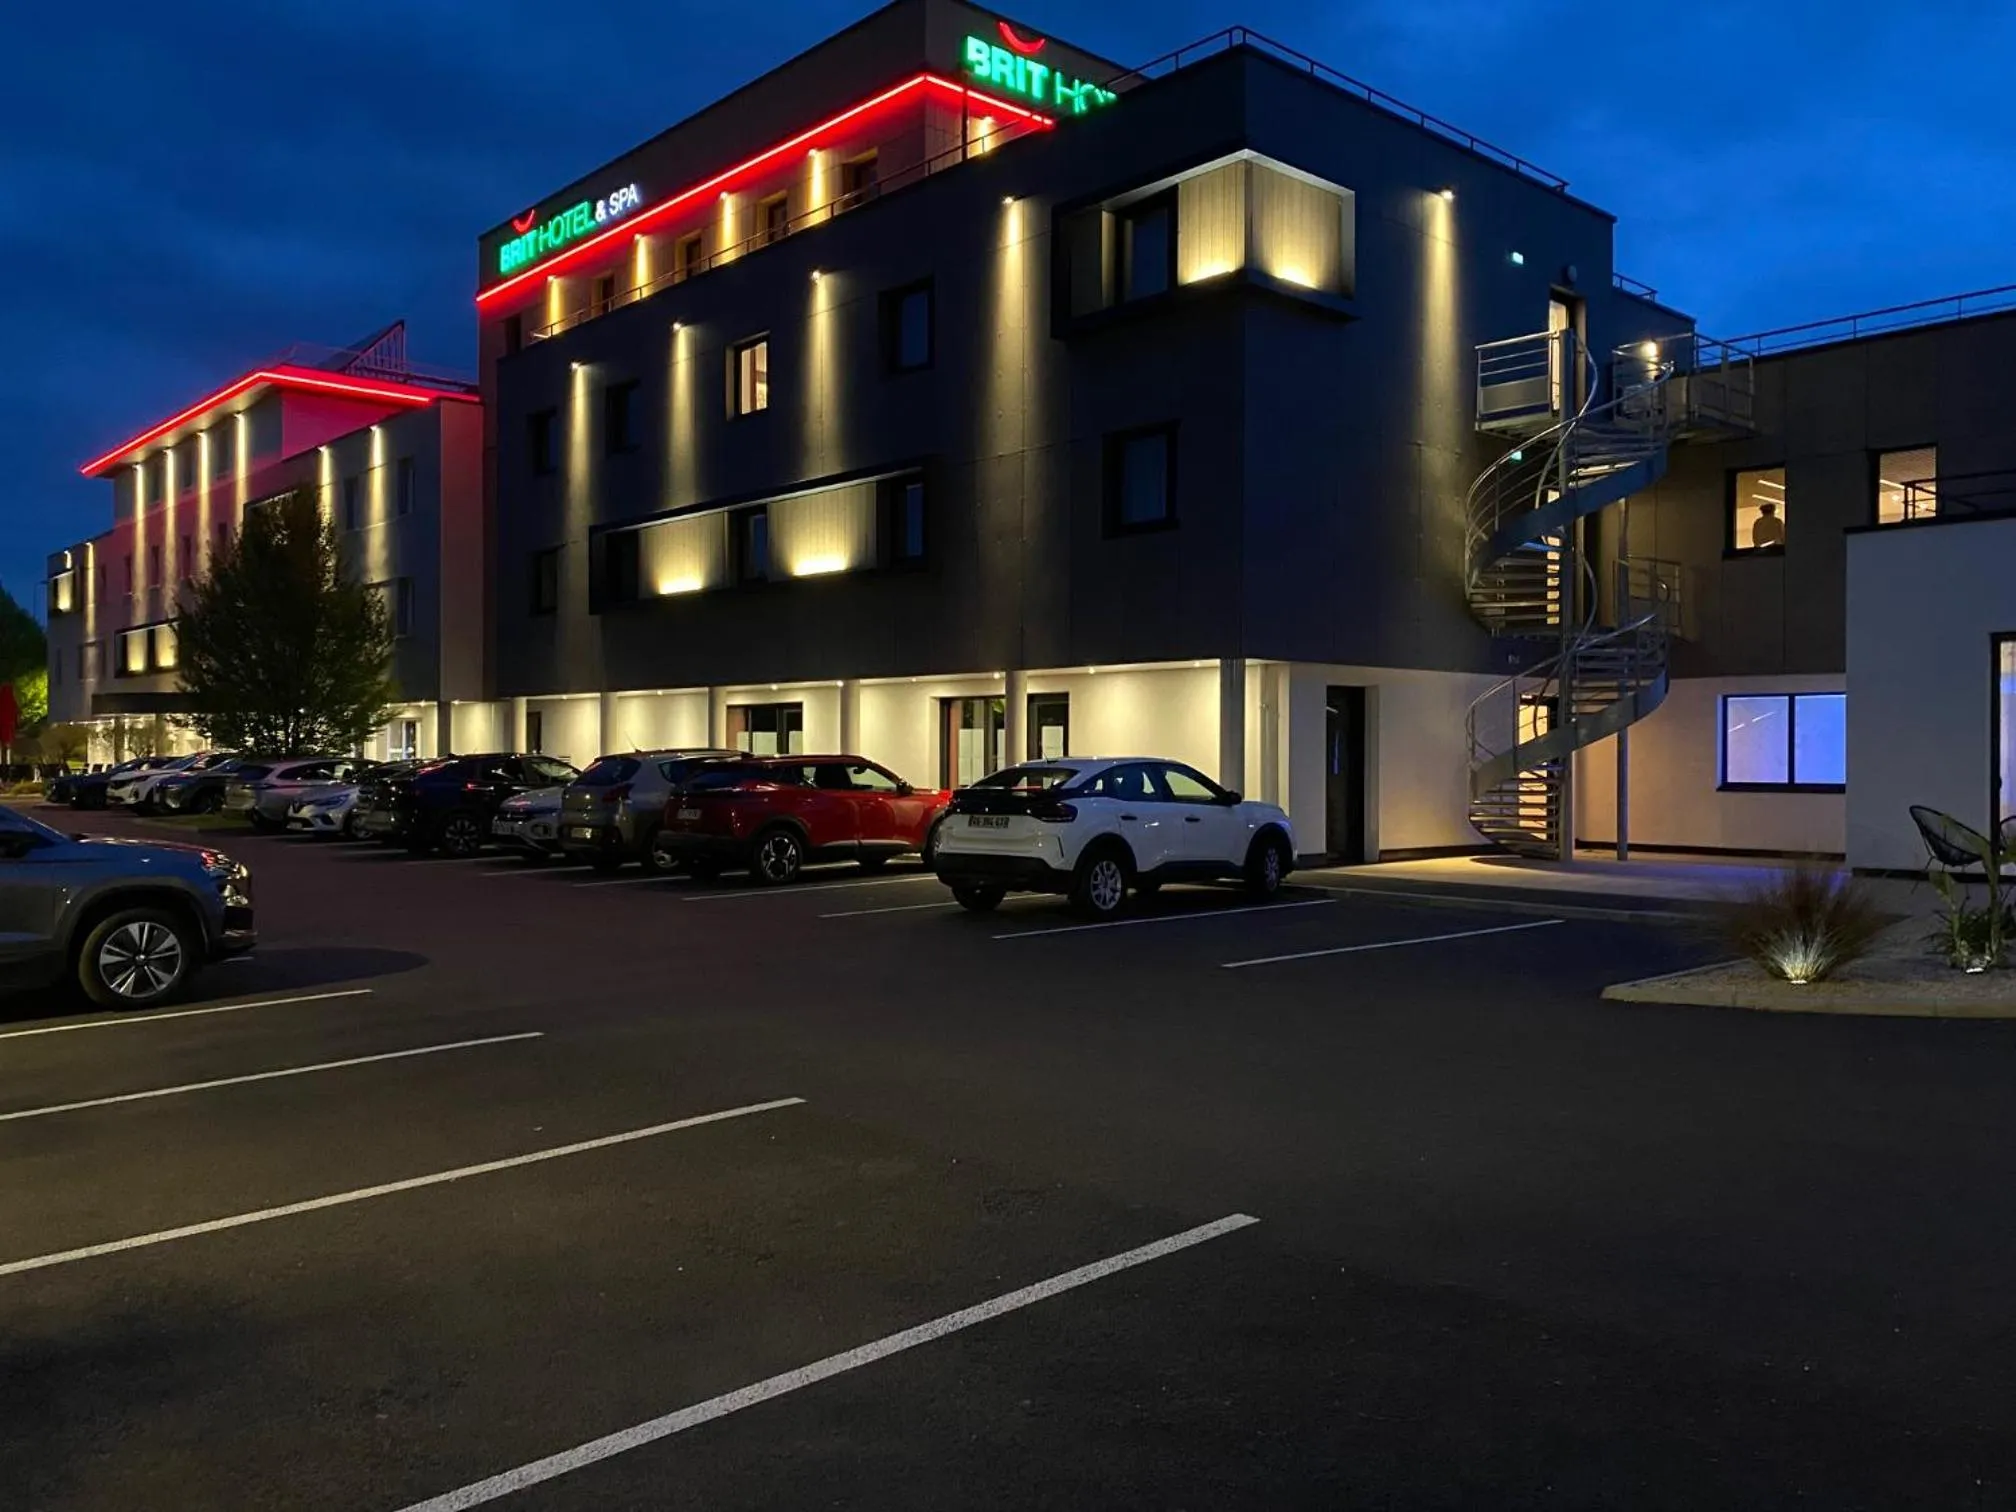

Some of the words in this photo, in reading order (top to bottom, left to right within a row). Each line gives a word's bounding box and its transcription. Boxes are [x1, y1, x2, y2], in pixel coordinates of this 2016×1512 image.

[966, 35, 1049, 101] BRIT
[500, 229, 538, 273] BRIT
[538, 201, 596, 253] HOTEL
[595, 199, 607, 223] &
[609, 183, 640, 216] SPA
